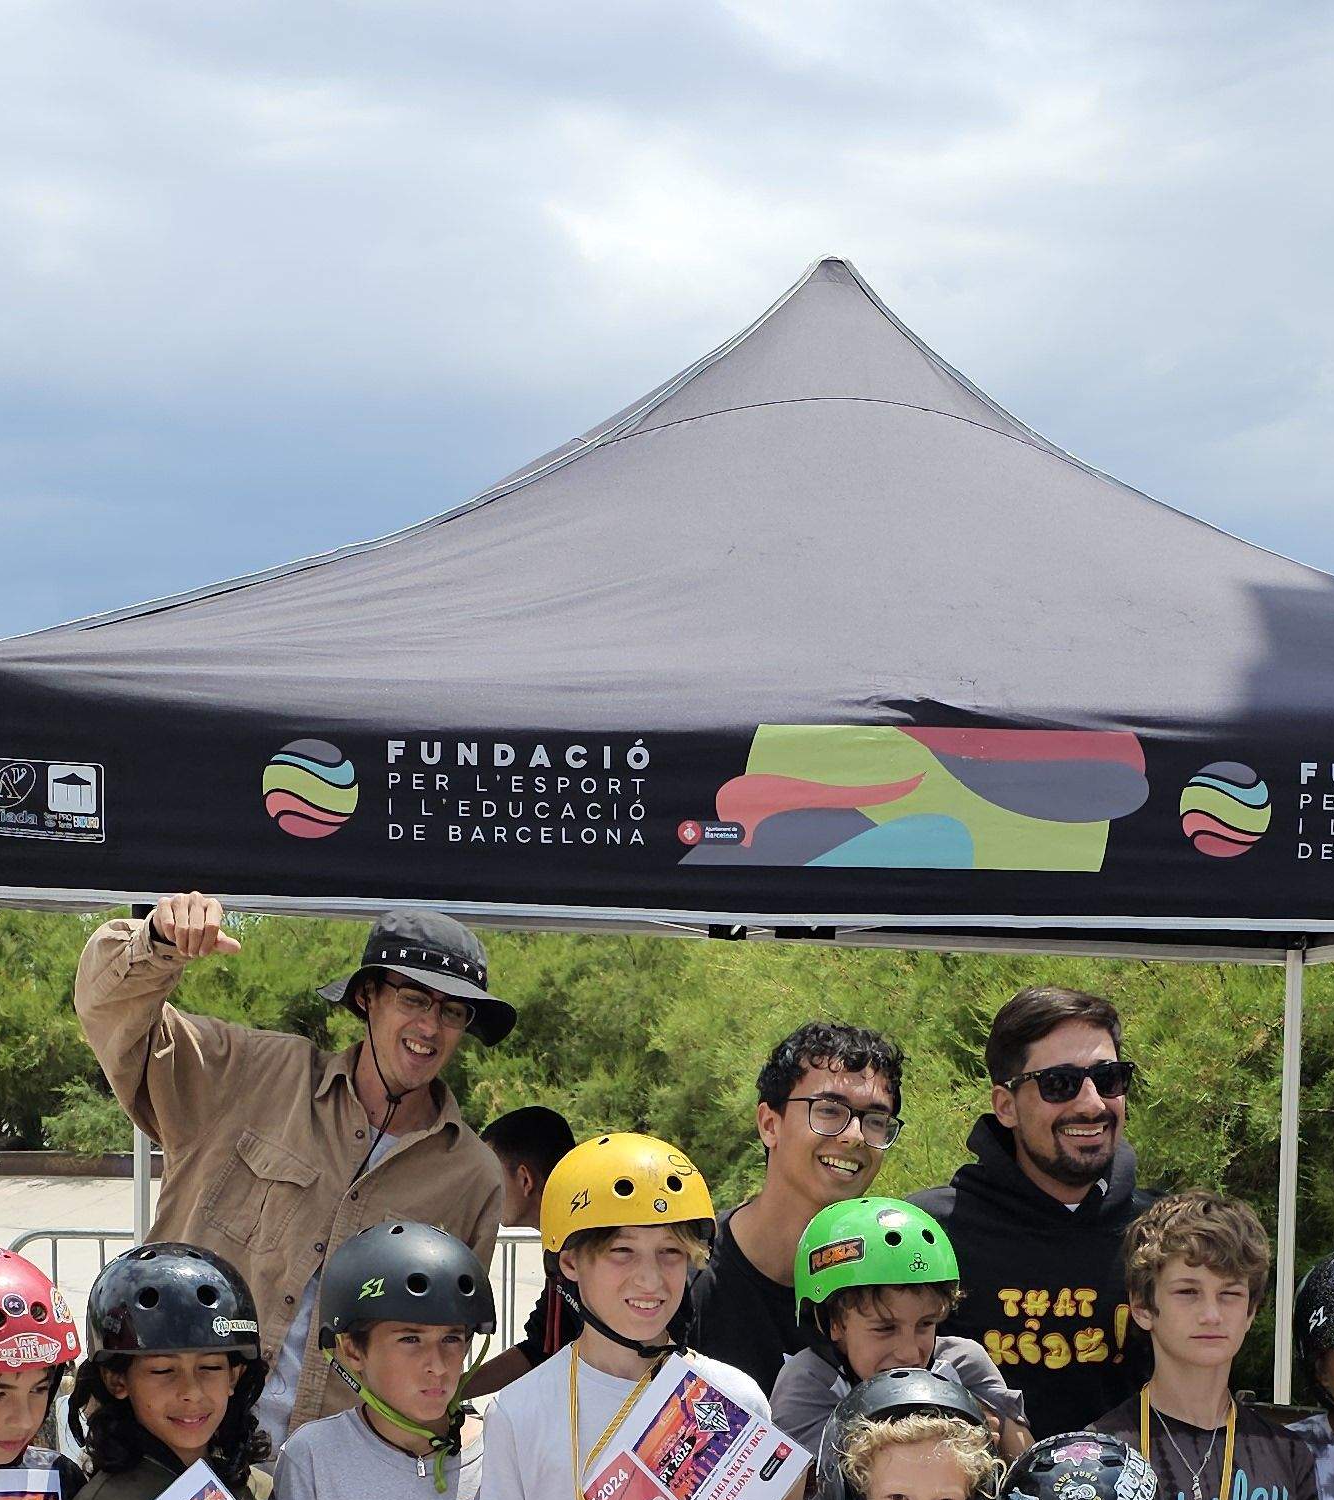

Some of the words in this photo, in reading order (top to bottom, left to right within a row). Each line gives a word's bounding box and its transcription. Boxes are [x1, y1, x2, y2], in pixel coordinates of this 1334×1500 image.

[387, 738, 650, 770] FUNDACIÓ
[388, 772, 449, 791] PER
[476, 774, 646, 796] L'ESPORT
[387, 798, 393, 816] I
[421, 798, 646, 821] L'EDUCACIÓ
[388, 823, 426, 841] DE
[448, 825, 646, 846] BARCELONA
[1297, 817, 1303, 835] I
[1297, 842, 1334, 860] DE
[357, 1277, 387, 1301] S1
[998, 1287, 1098, 1318] THAT
[14, 1336, 40, 1348] VANS
[670, 1443, 694, 1468] 2024
[724, 1446, 752, 1481] SKATE
[749, 1425, 769, 1451] BCN
